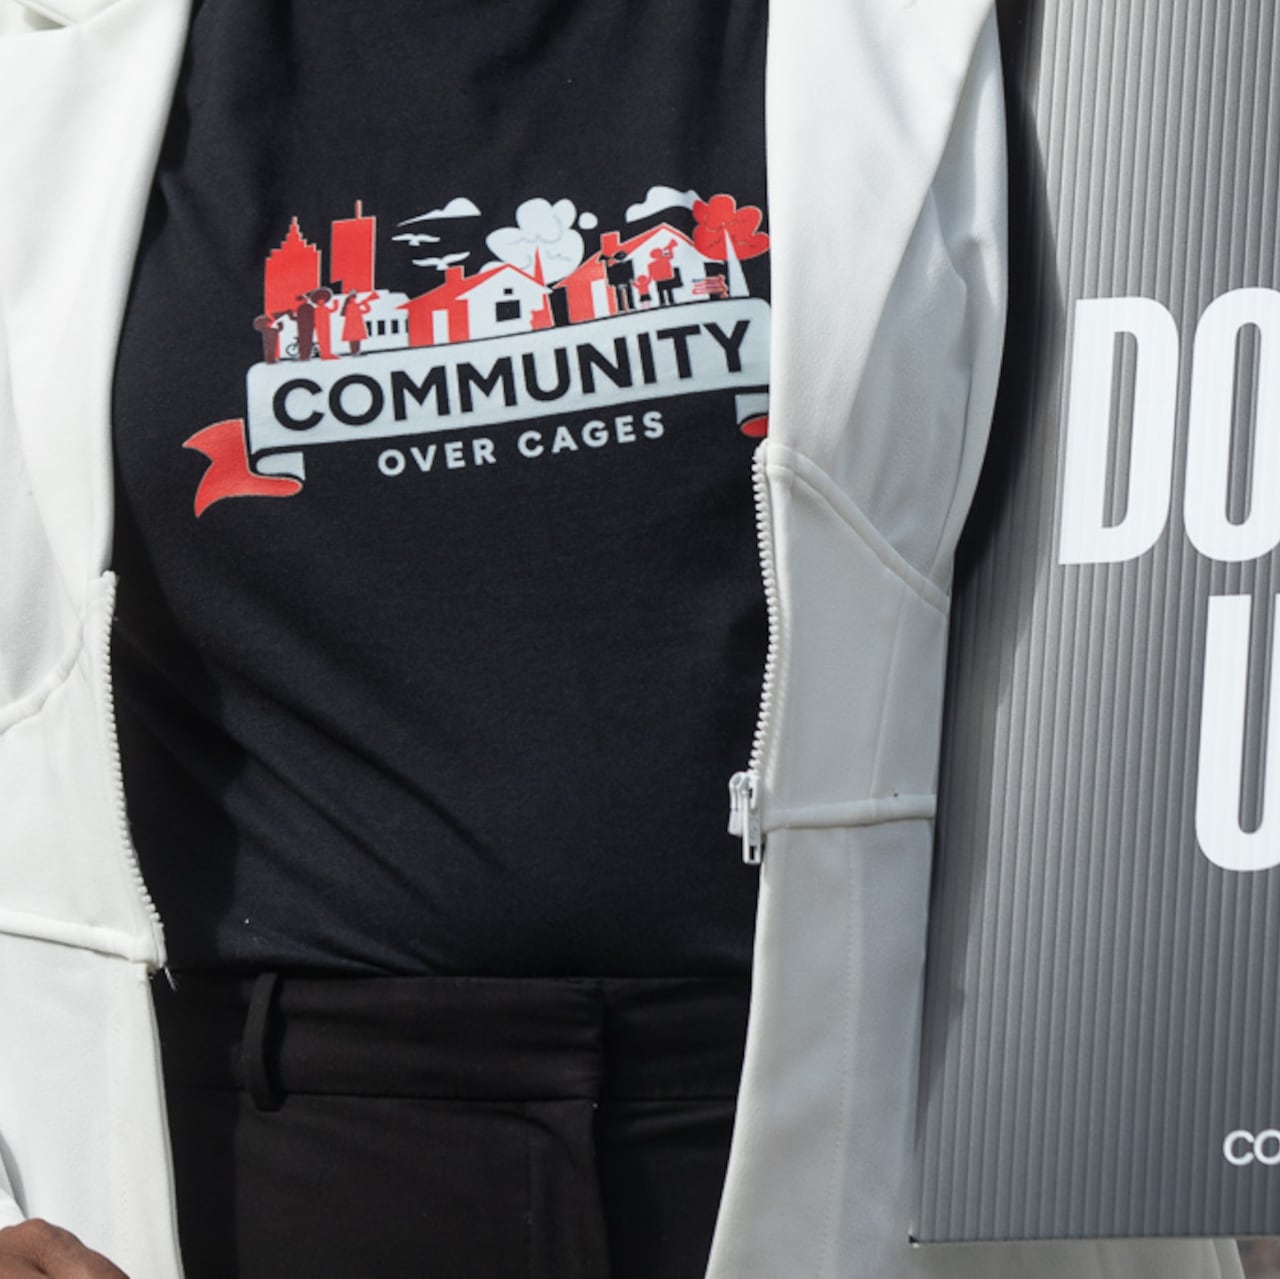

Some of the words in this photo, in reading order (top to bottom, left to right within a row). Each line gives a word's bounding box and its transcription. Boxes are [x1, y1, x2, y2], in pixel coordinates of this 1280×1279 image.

[271, 319, 751, 431] COMMUNITY
[377, 440, 497, 478] OVER
[517, 410, 666, 459] CAGES
